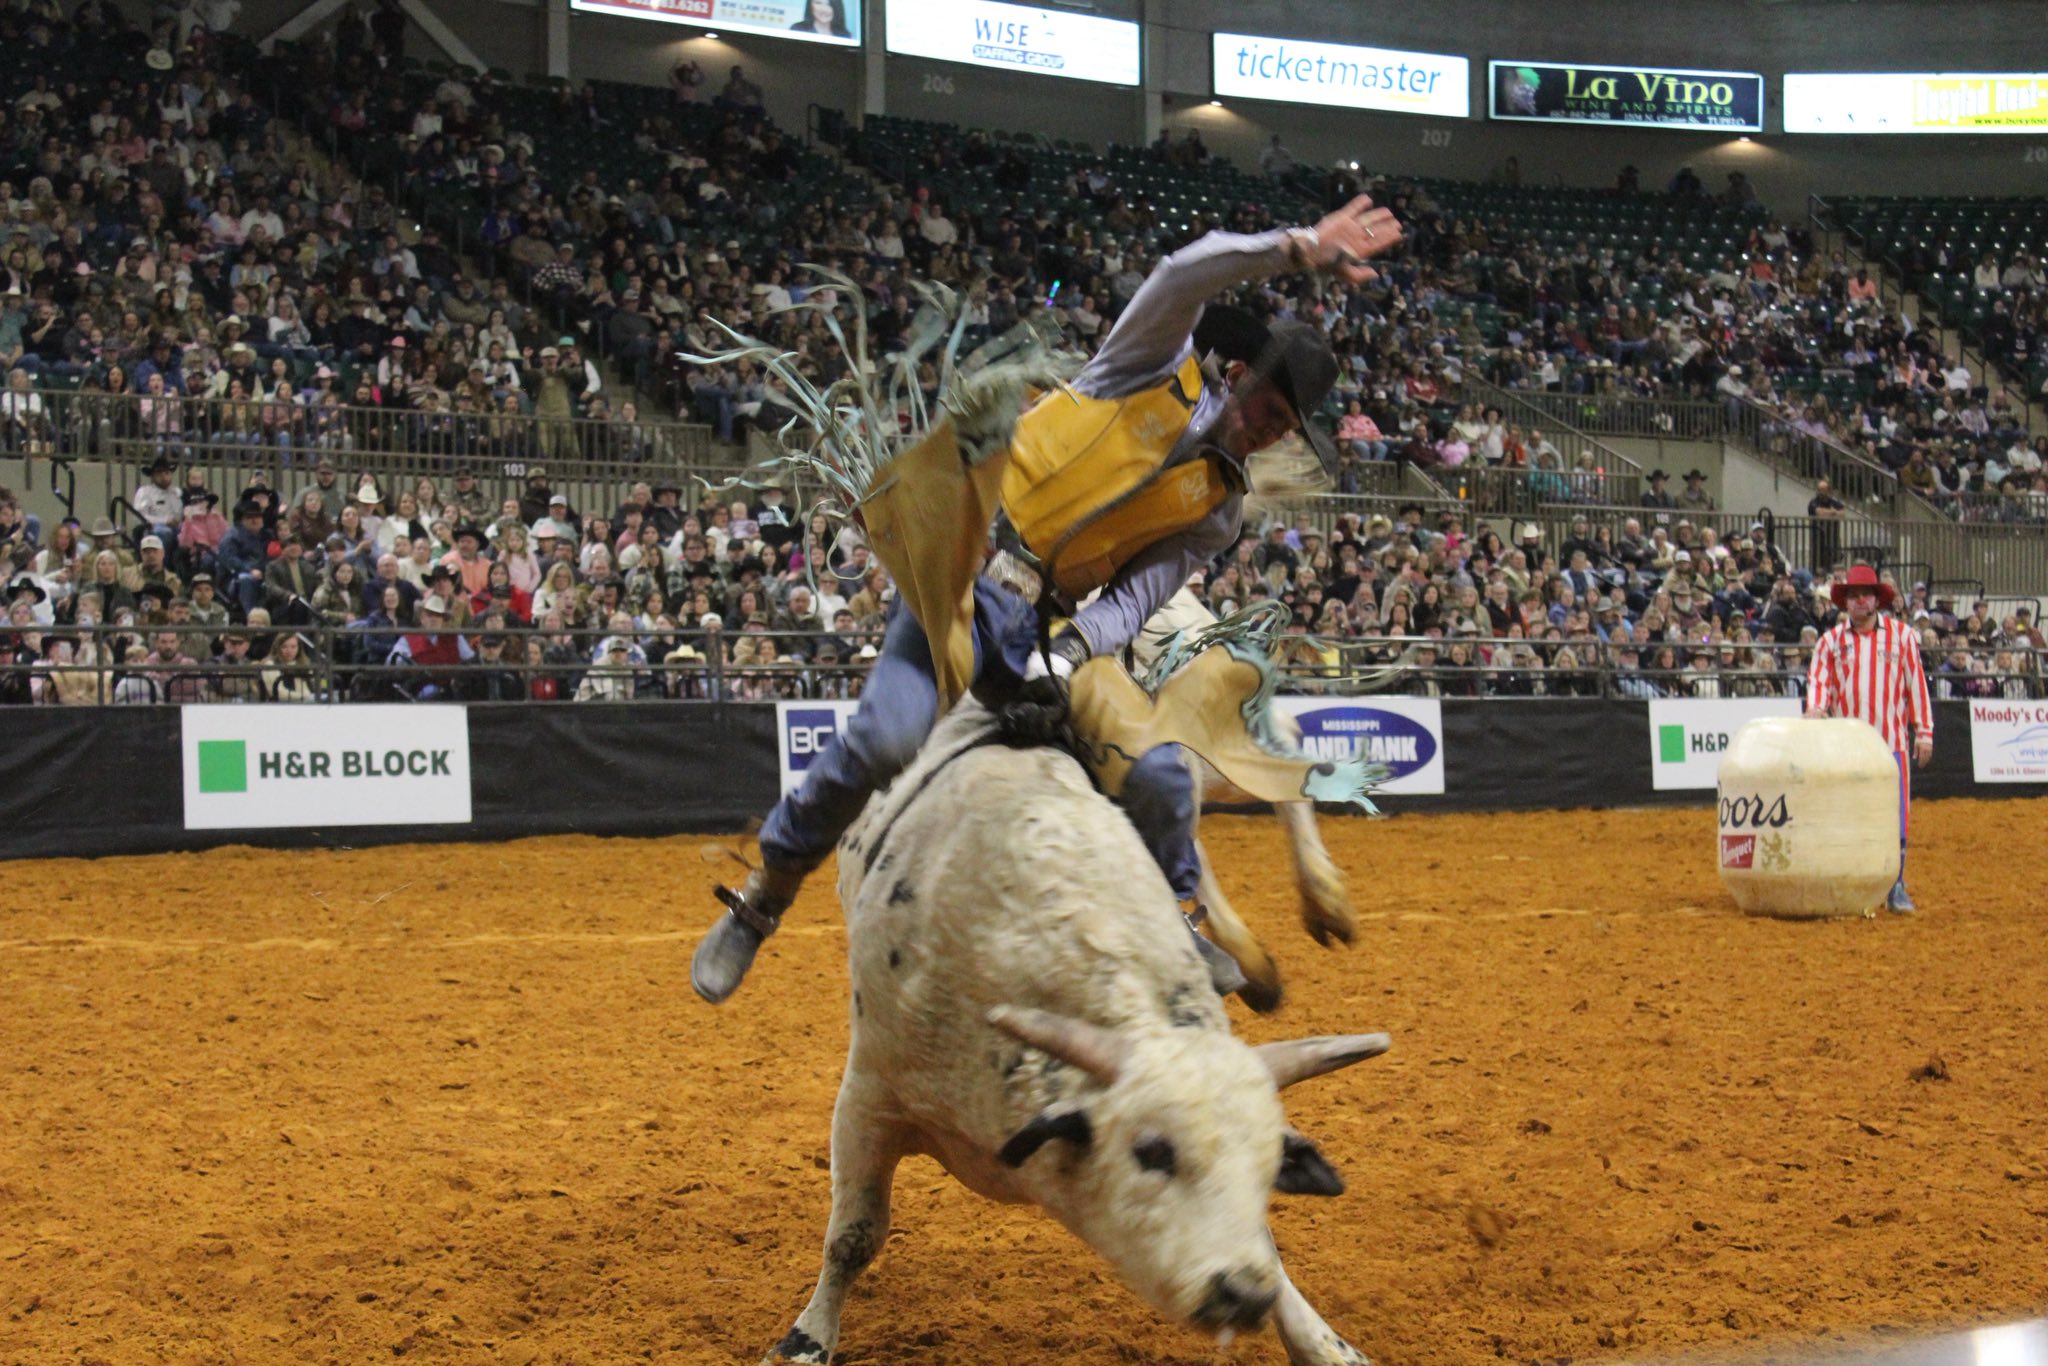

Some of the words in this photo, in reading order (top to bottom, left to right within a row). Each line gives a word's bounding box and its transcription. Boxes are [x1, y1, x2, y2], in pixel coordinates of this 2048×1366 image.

[975, 18, 1029, 46] WISE
[974, 45, 1024, 63] STAFFING
[1025, 52, 1063, 68] GROUP
[1236, 44, 1441, 93] ticketmaster
[922, 74, 955, 94] 206
[1565, 69, 1619, 100] La
[1634, 73, 1733, 105] Vino
[1565, 99, 1610, 111] WINE
[1621, 101, 1656, 113] AND
[1666, 103, 1732, 116] SPIRITS
[1421, 129, 1453, 147] 207
[504, 463, 526, 477] 103
[1322, 720, 1380, 731] MISSISSIPPI
[1974, 707, 2031, 727] Moody's
[2035, 708, 2048, 723] C
[1302, 736, 1350, 762] AND
[1691, 733, 1729, 752] H&R
[260, 752, 331, 778] H&R
[342, 750, 452, 777] BLOCK
[1718, 781, 1793, 828] oors
